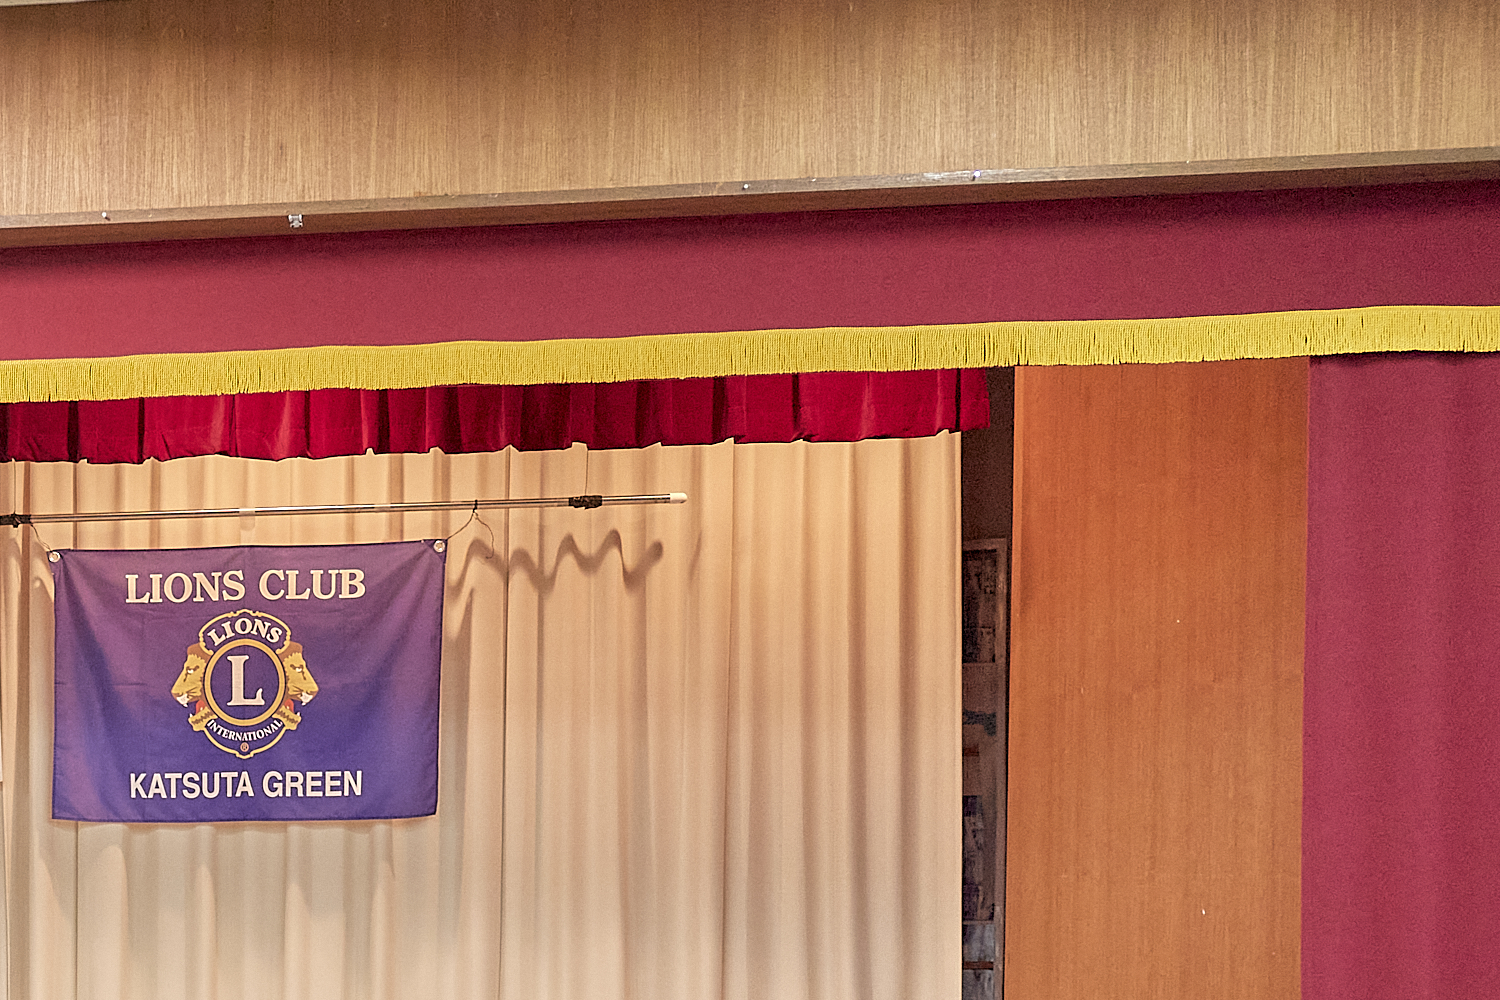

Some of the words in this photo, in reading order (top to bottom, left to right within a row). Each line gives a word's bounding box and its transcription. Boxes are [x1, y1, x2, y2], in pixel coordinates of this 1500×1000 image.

[125, 570, 246, 603] LIONS
[259, 568, 366, 600] CLUB
[207, 618, 283, 647] LIONS
[226, 655, 266, 706] L
[206, 719, 283, 742] INTERNATIONAL
[129, 771, 254, 799] KATSUTA
[262, 770, 363, 797] GREEN
